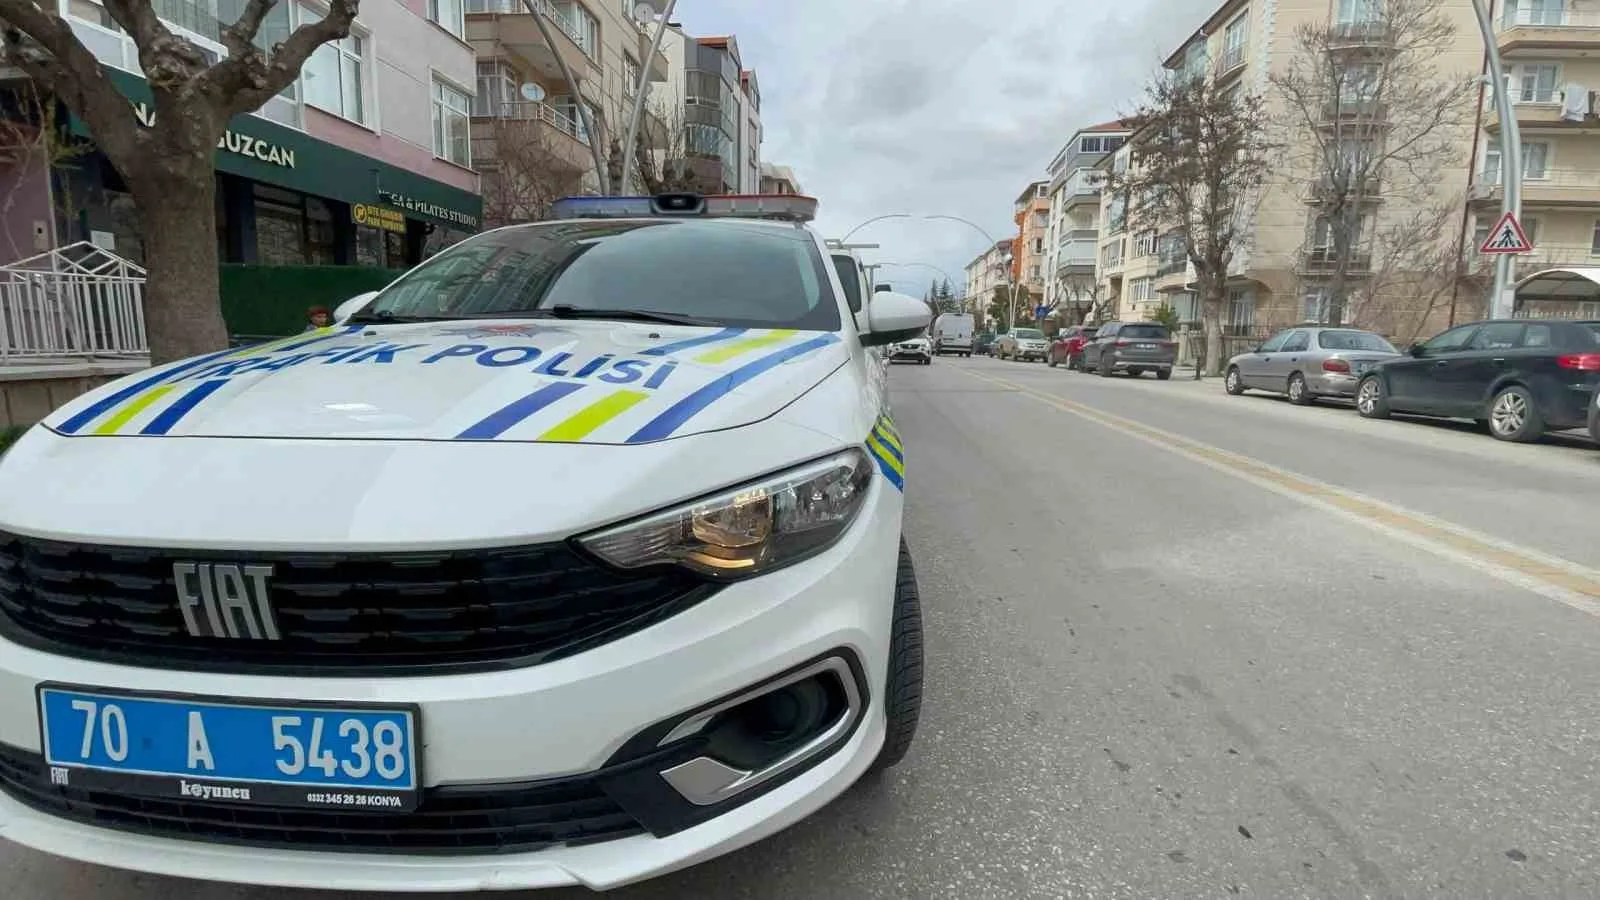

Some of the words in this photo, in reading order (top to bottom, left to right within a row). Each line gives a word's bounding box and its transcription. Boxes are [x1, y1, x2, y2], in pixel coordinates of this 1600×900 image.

[217, 129, 296, 169] UZCAN
[415, 200, 449, 220] PILATES
[449, 210, 477, 227] STUDIO
[420, 344, 679, 389] POLİSİ
[173, 563, 281, 640] FIAT
[72, 701, 128, 762] 70
[187, 711, 215, 770] A
[271, 716, 404, 779] 5438
[51, 766, 69, 785] FIAT
[325, 793, 342, 804] 345
[367, 796, 402, 807] KONYA
